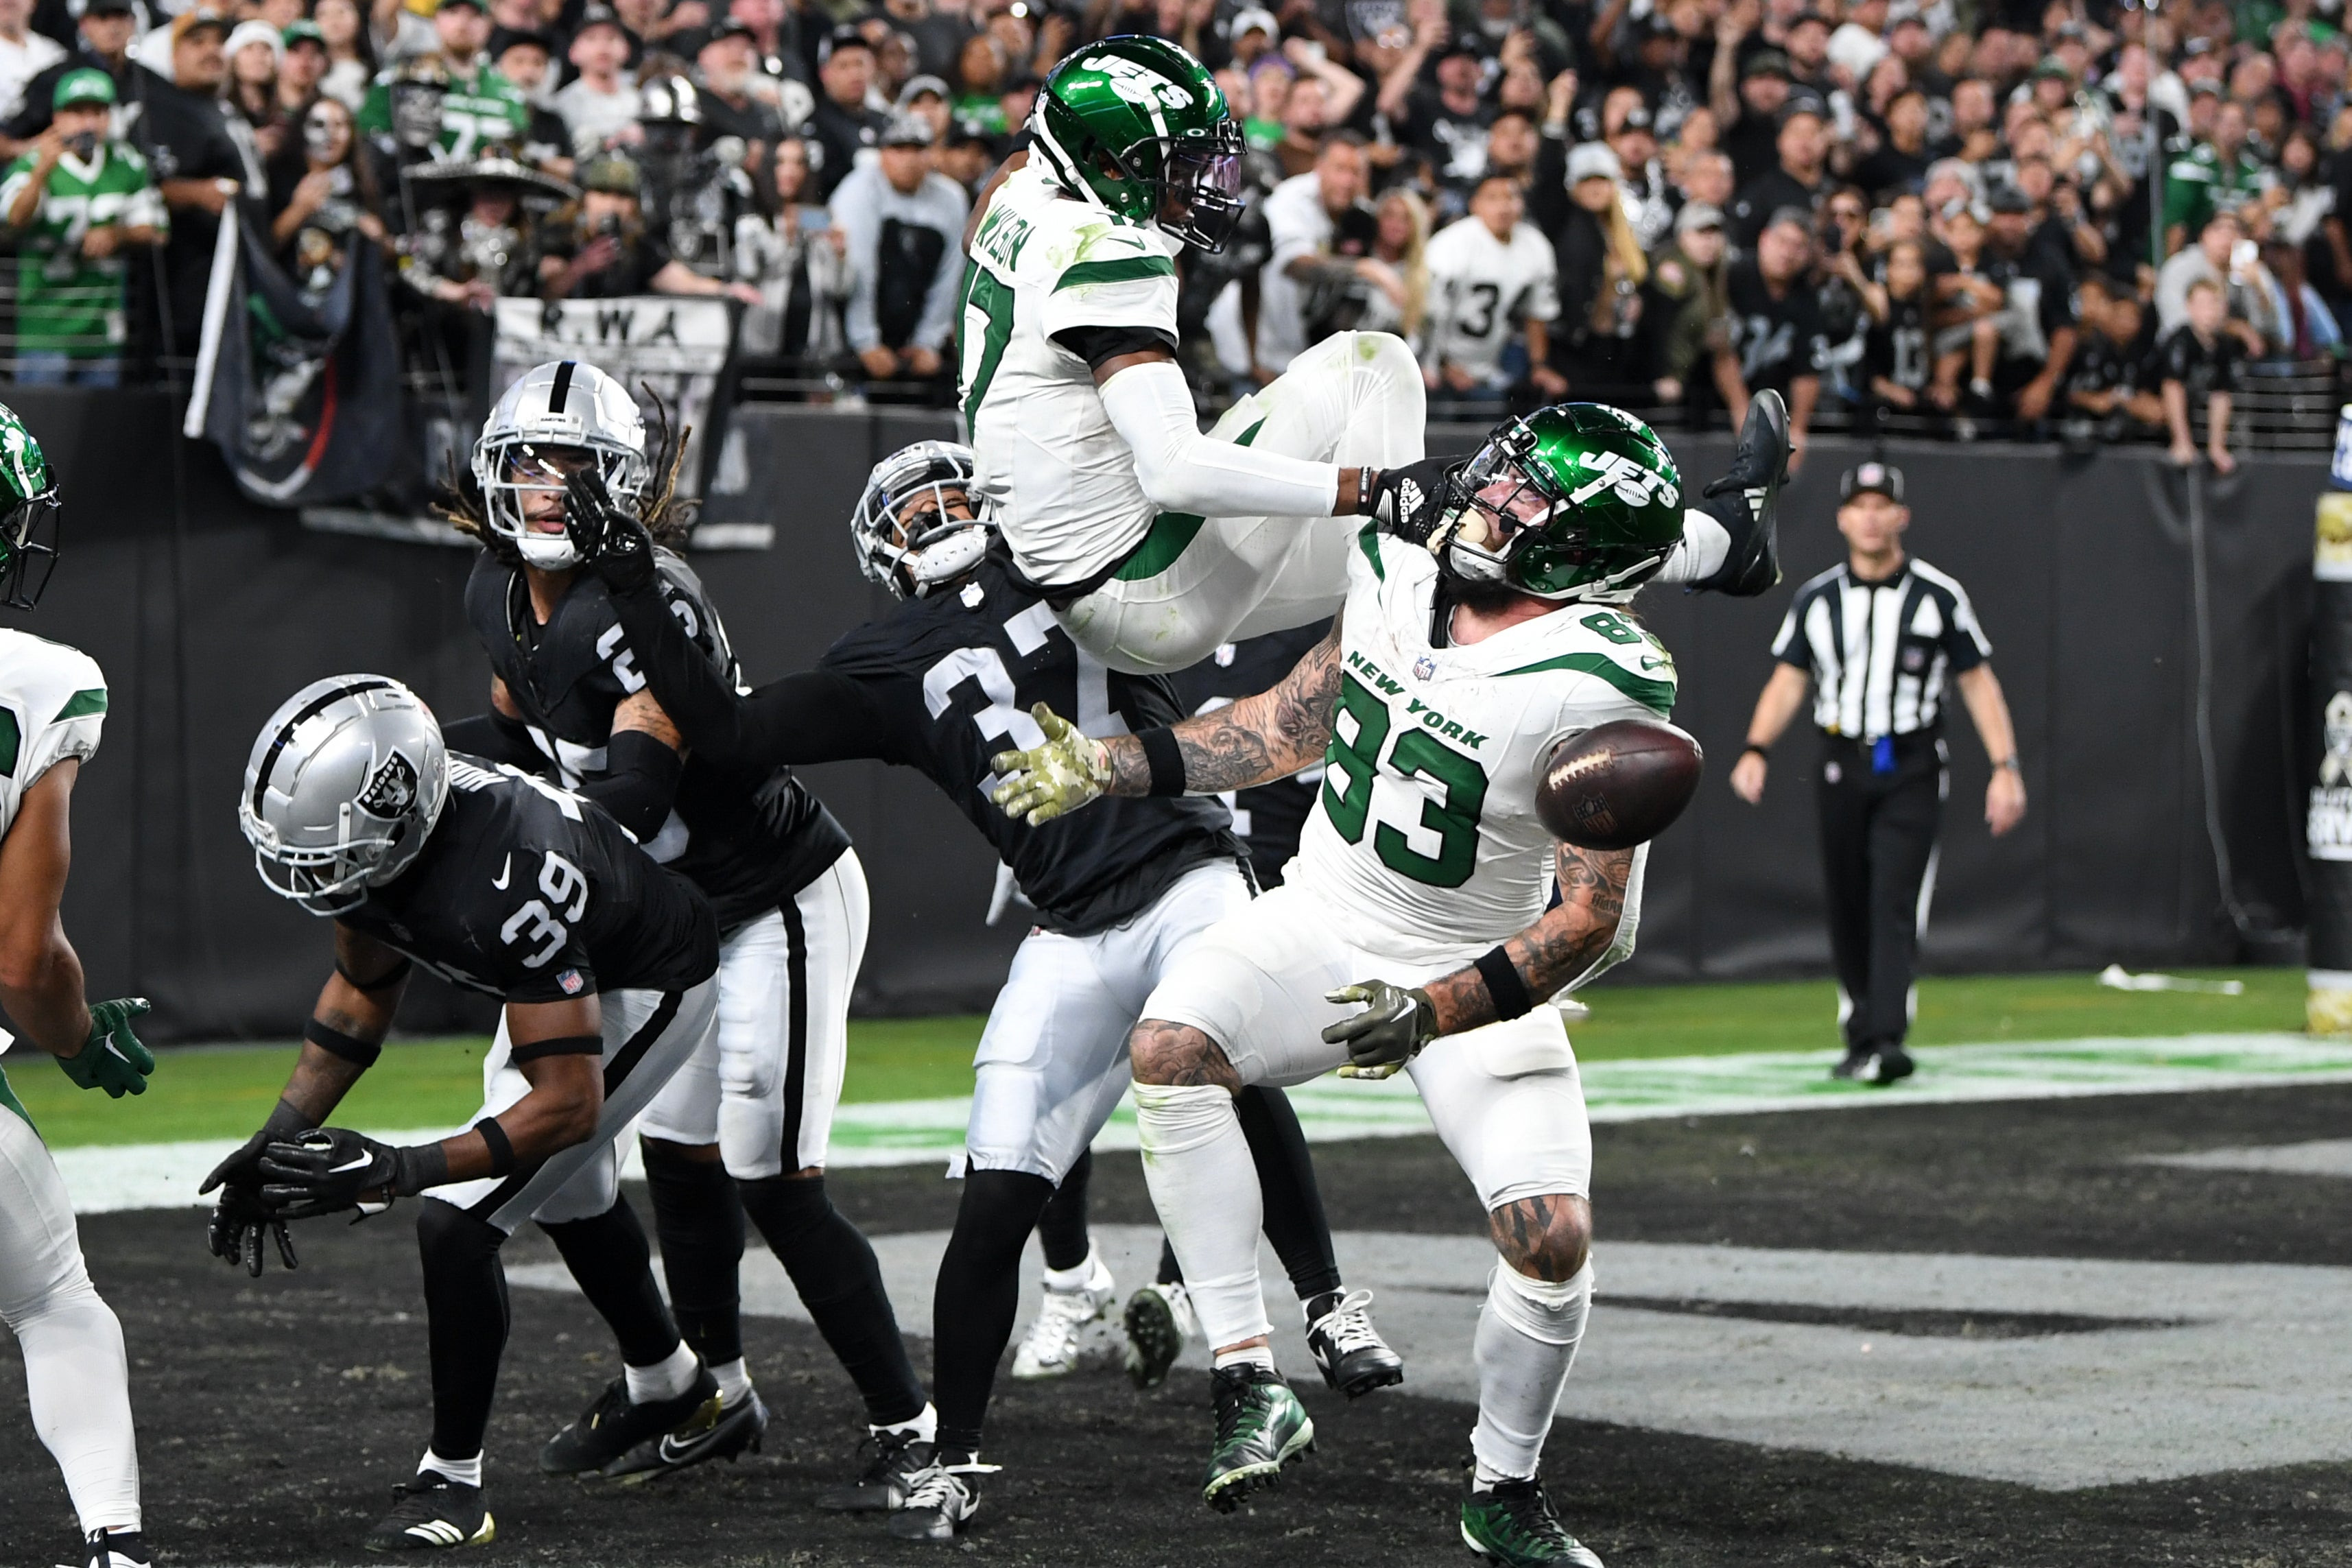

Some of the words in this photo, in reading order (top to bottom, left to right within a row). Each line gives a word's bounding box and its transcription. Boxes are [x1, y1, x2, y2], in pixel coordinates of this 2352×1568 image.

[1081, 54, 1194, 110] JETS
[1399, 477, 1412, 523] adidas
[1578, 450, 1680, 509] JETS
[1346, 650, 1406, 696] NEW
[1405, 697, 1490, 750] YORK
[363, 756, 398, 804] RAIDERS
[1322, 668, 1490, 888] 83
[499, 849, 589, 969] 39
